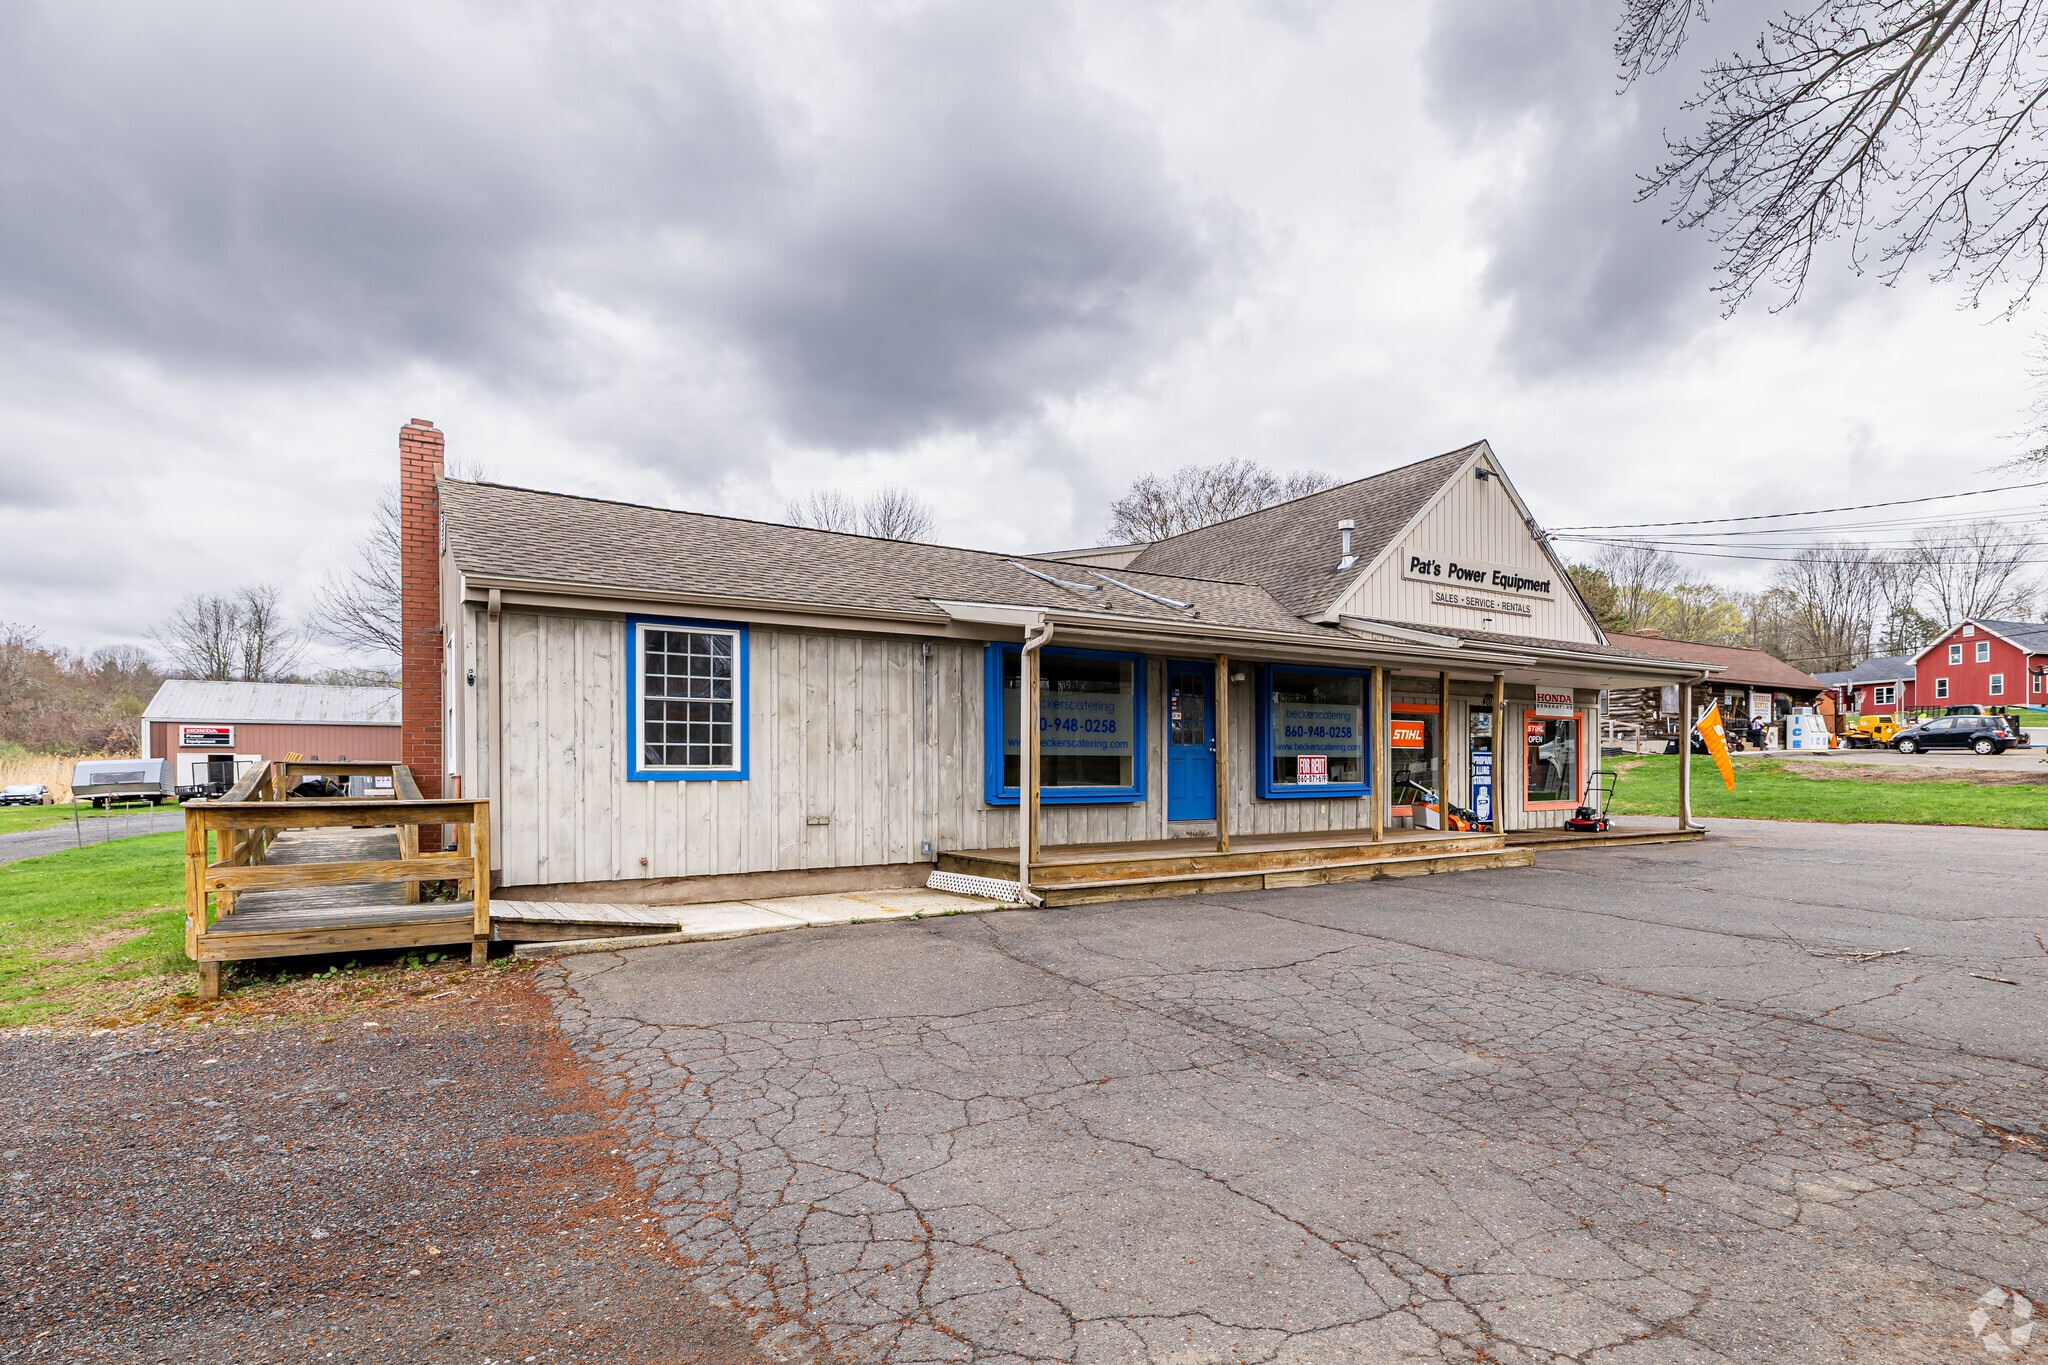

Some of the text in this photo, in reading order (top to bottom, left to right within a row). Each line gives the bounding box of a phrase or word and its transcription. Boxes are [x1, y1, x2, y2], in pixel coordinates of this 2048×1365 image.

[1409, 556, 1551, 594] Pat's Power Equipment
[1435, 592, 1531, 614] SALES SERVICE RENTALS
[1537, 693, 1572, 703] HONDA
[1040, 698, 1115, 714] ckerscatering
[1286, 709, 1351, 722] beckerscatering
[1040, 717, 1117, 733] 0-948-0258
[1285, 725, 1352, 738] 860-948-0258
[1393, 729, 1422, 740] STIHL
[1792, 716, 1802, 748] ICE
[1008, 738, 1129, 751] wweckerscatering.com
[1528, 735, 1543, 743] OPEN
[1277, 743, 1361, 753] www.beckerscatering.com
[1299, 758, 1325, 774] FOR RENT
[1473, 756, 1492, 765] PROPAN
[1475, 765, 1490, 775] ILLING
[1473, 776, 1492, 785] STATION
